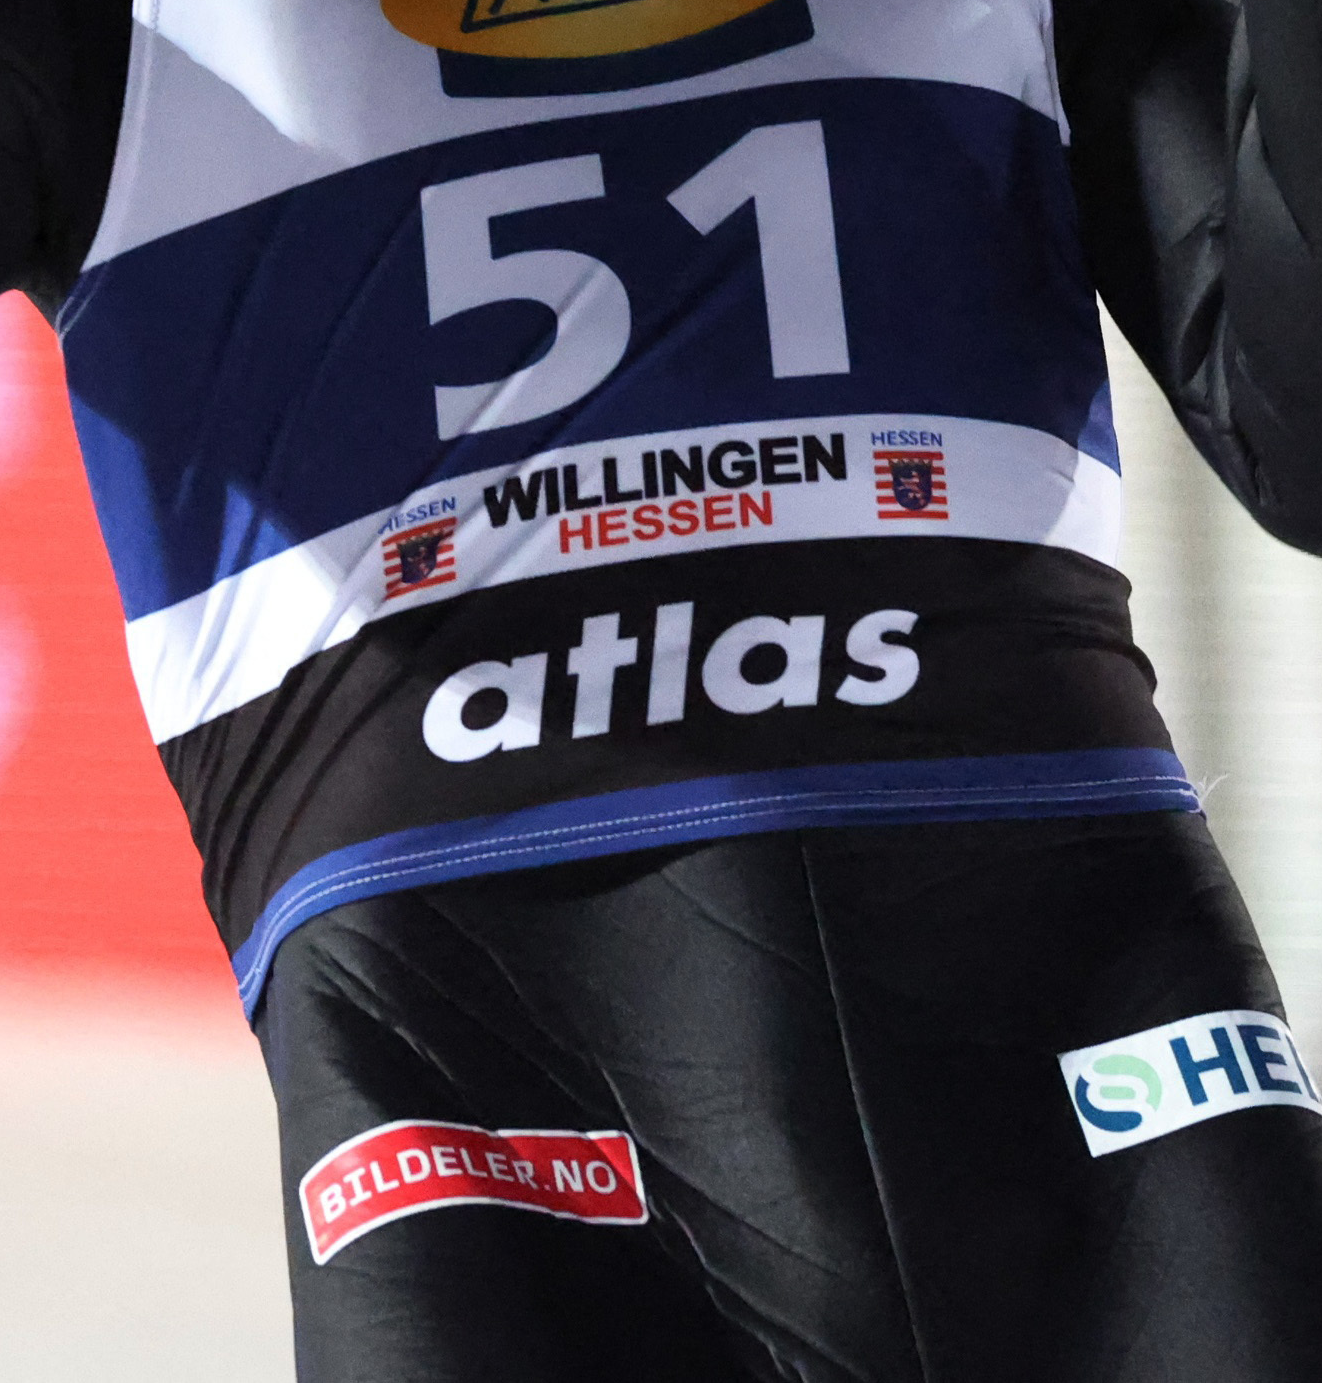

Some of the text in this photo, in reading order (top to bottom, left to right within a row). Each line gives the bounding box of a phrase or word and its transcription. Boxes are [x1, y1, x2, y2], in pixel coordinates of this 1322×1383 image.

[420, 119, 850, 442] 51
[484, 433, 847, 528] WILLINGEN
[871, 430, 944, 448] HESSEN
[559, 491, 774, 554] HESSEN
[422, 601, 920, 763] atlas
[319, 1145, 618, 1224] BILDELER.NO
